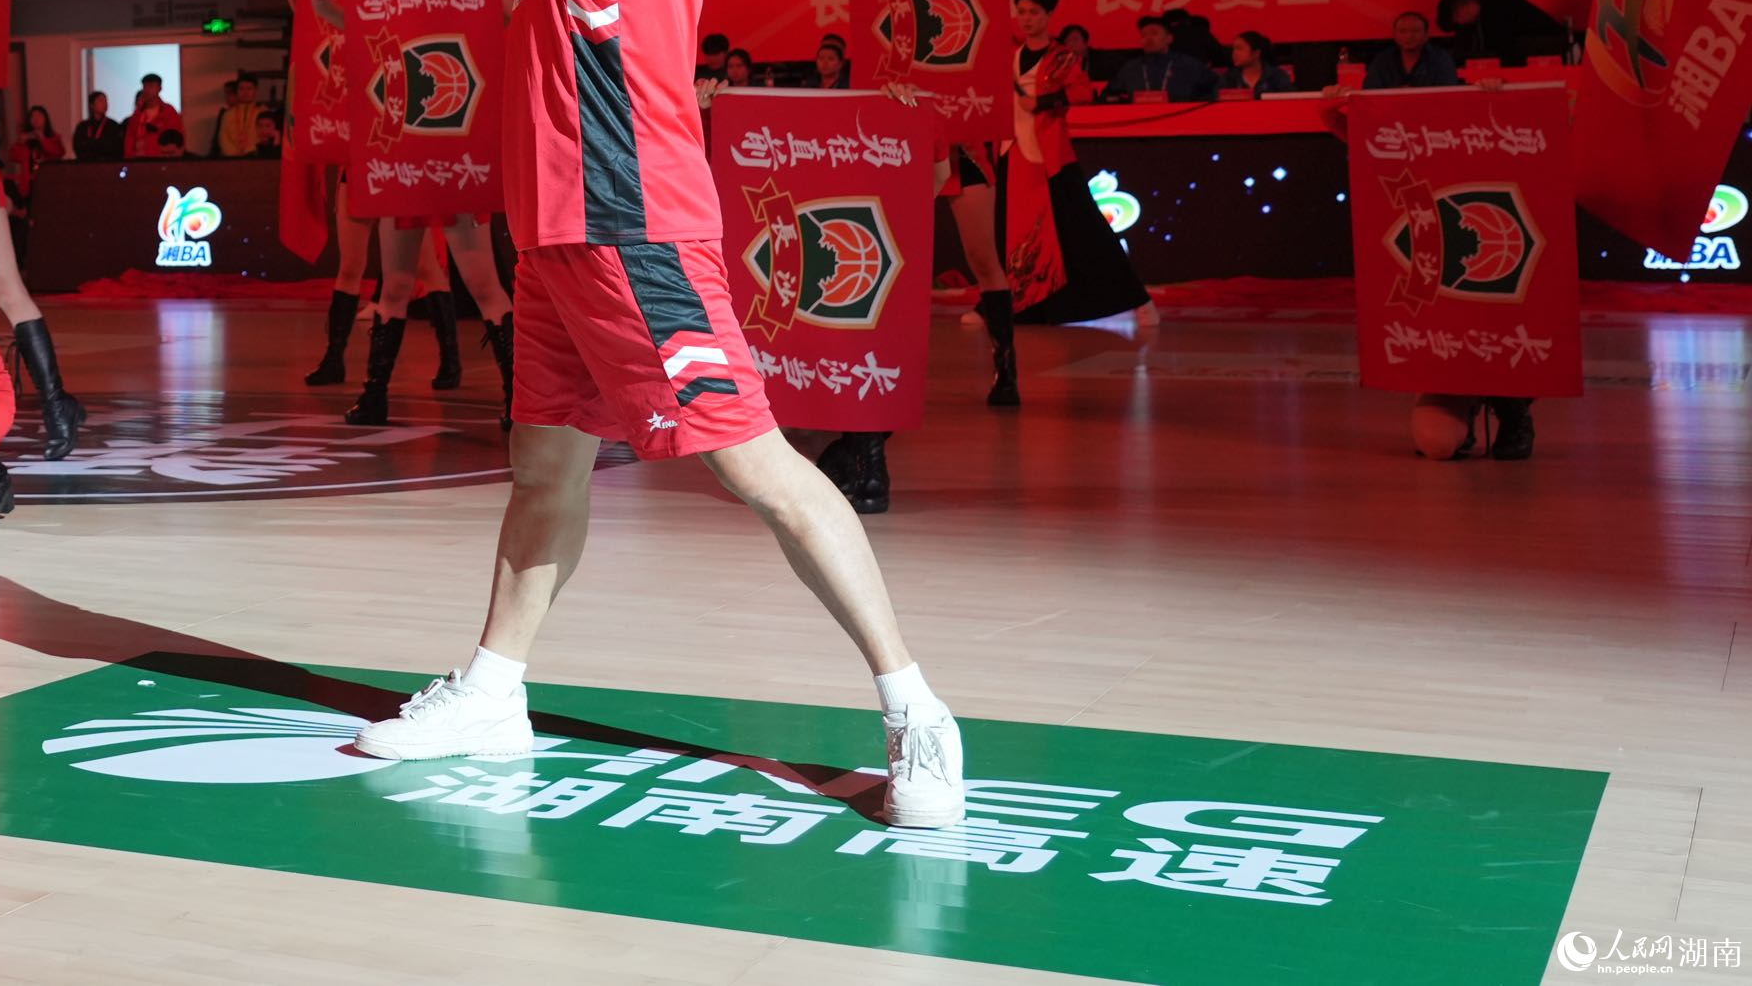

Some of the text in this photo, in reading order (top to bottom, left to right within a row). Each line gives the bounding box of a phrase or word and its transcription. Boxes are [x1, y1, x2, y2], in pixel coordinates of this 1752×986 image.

[730, 109, 913, 172] 勇往直前
[1365, 102, 1547, 163] 勇往直前
[366, 153, 492, 195] 长沙当先
[161, 246, 207, 262] 湘BA
[1383, 320, 1553, 370] 长沙当先
[384, 766, 1341, 906] 湖南高速
